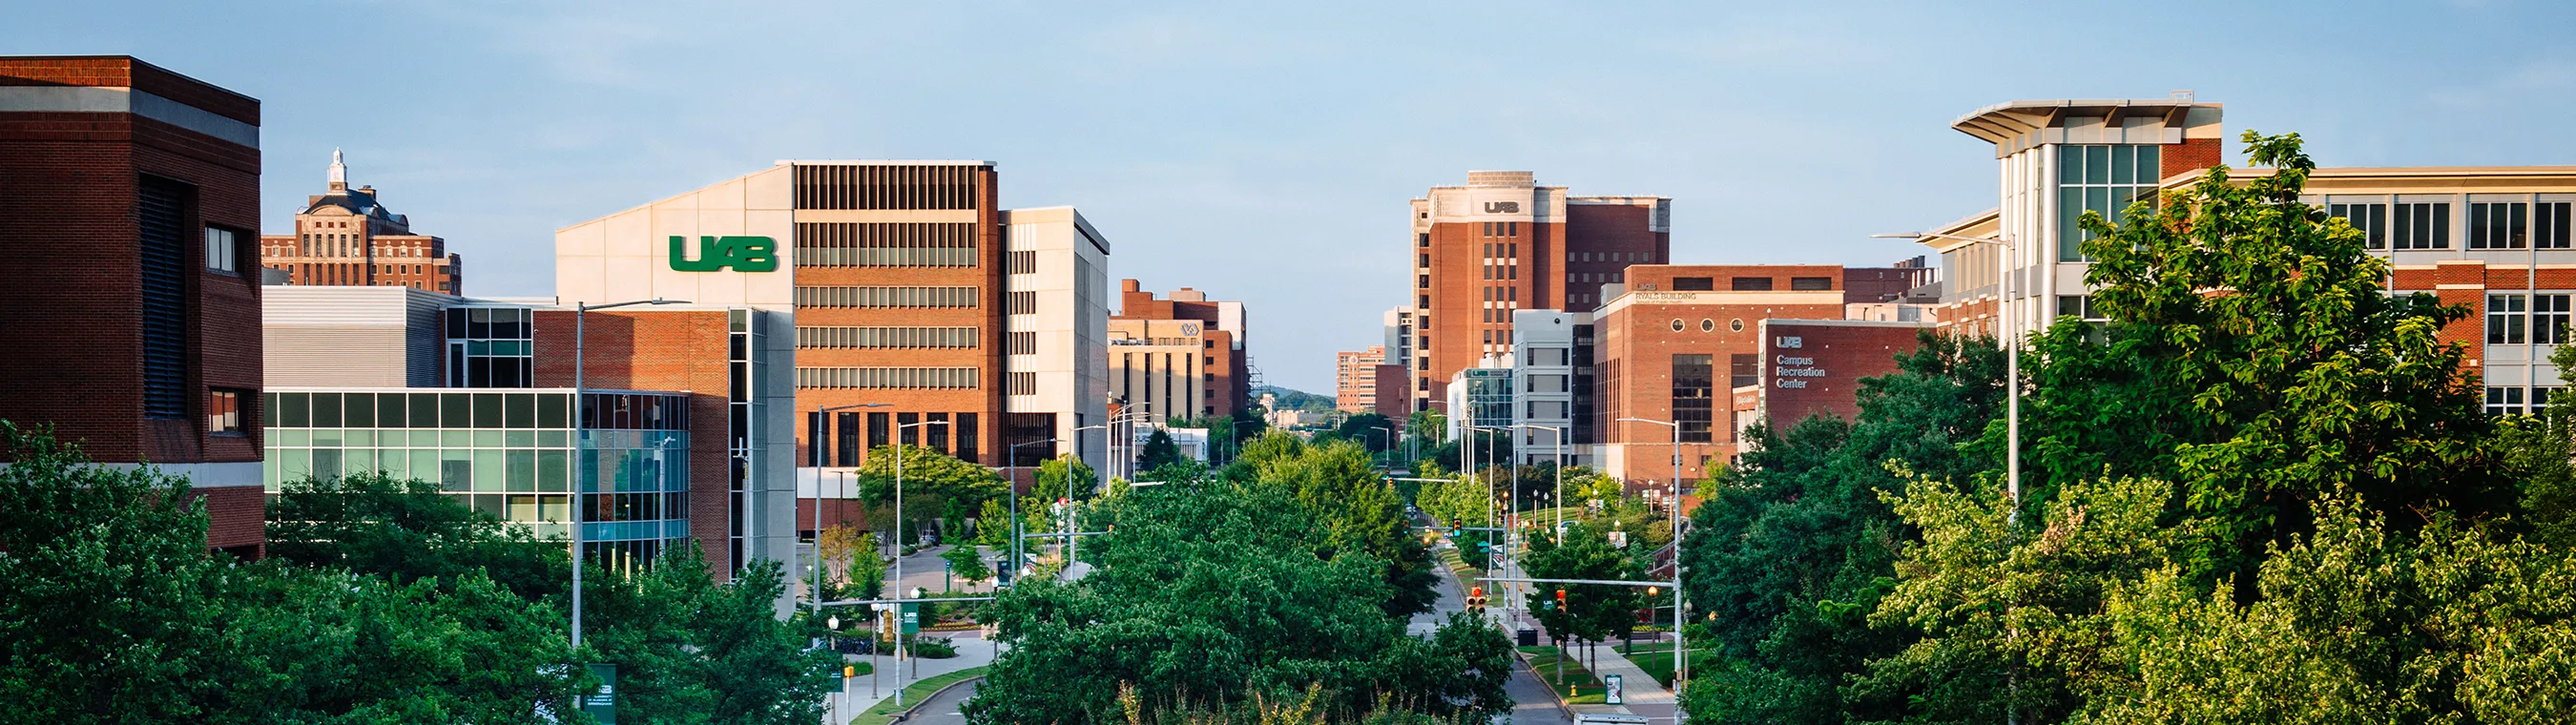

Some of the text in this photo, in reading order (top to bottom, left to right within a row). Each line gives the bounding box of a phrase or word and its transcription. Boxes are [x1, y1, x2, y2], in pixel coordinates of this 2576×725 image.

[1485, 201, 1520, 214] UAB
[669, 236, 777, 272] UAB
[1776, 337, 1802, 349] UAB
[1776, 354, 1814, 367] Campus
[1776, 366, 1826, 377] Recreation
[1776, 379, 1808, 389] Center
